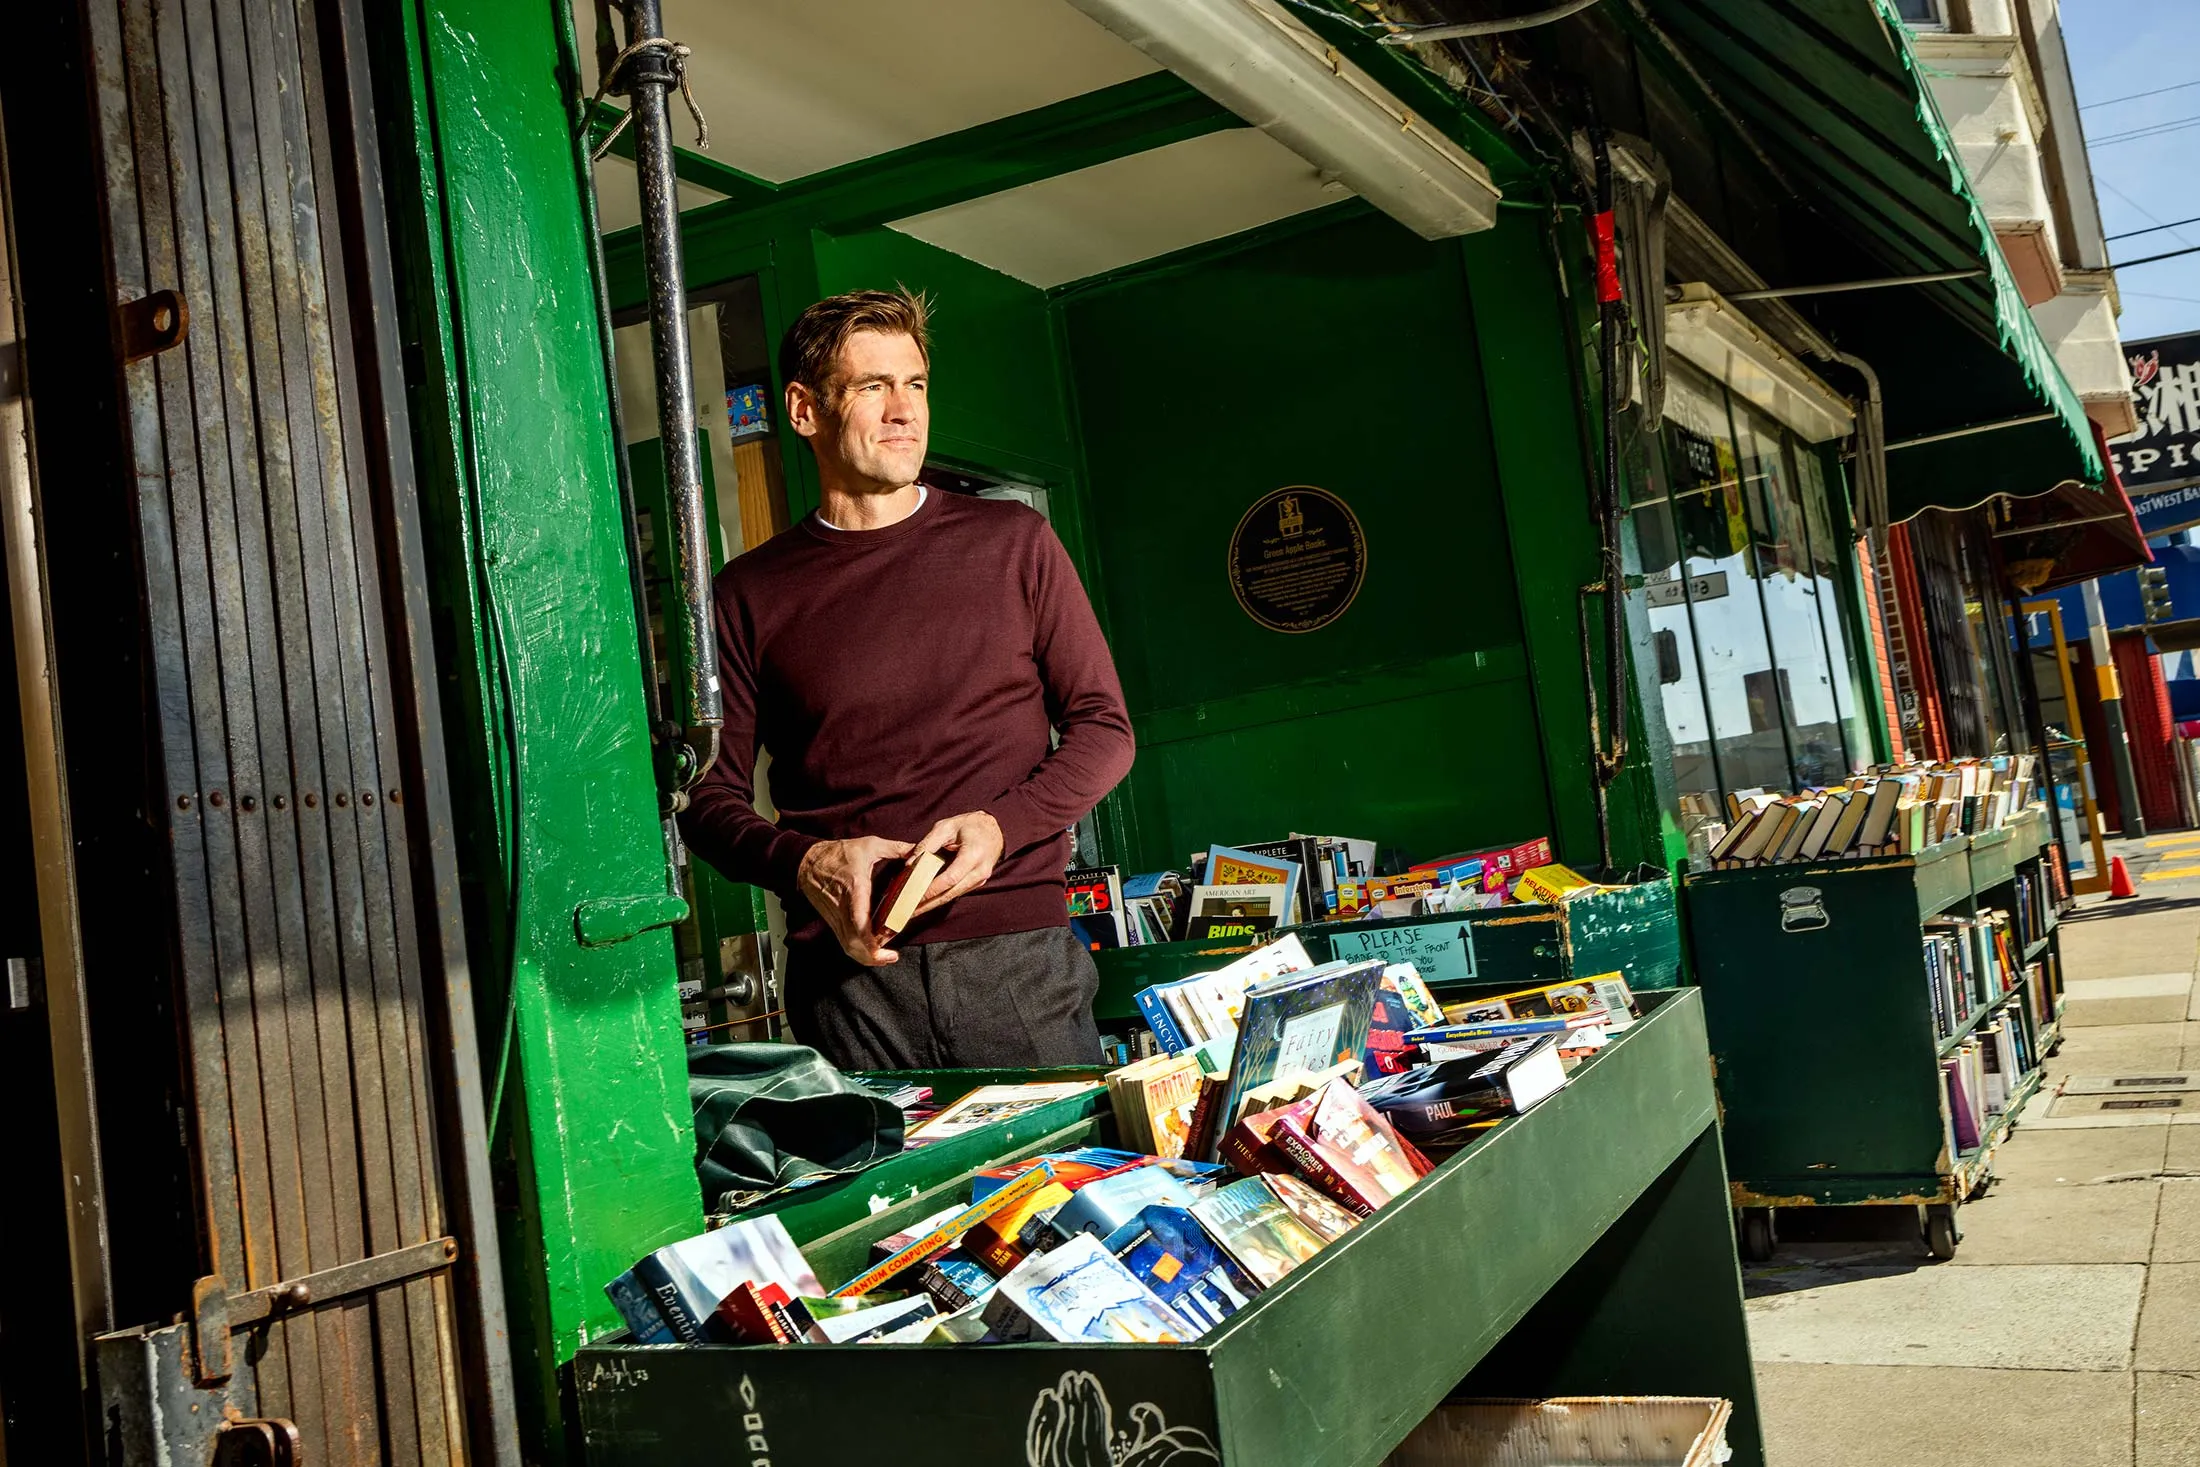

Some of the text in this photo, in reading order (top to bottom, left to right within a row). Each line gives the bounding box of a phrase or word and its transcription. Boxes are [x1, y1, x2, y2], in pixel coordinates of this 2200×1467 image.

[1204, 890, 1240, 898] AMERICAN
[1523, 877, 1558, 902] RELATIVE
[1358, 928, 1424, 951] PLEASE
[1377, 950, 1390, 959] TO
[1396, 945, 1417, 955] THE
[1424, 941, 1450, 954] FRONT
[1415, 956, 1433, 965] YOU
[1285, 1027, 1335, 1056] Fairy
[1425, 1102, 1457, 1123] PAUL
[1285, 1135, 1324, 1174] EXPLORER
[1286, 1145, 1316, 1174] ACADEMY
[888, 1234, 943, 1272] COMPUTING
[944, 1225, 957, 1236] for
[960, 1208, 987, 1229] babies
[996, 1250, 1012, 1268] TRAN
[750, 1287, 772, 1321] SOLVING
[766, 1317, 784, 1338] THE
